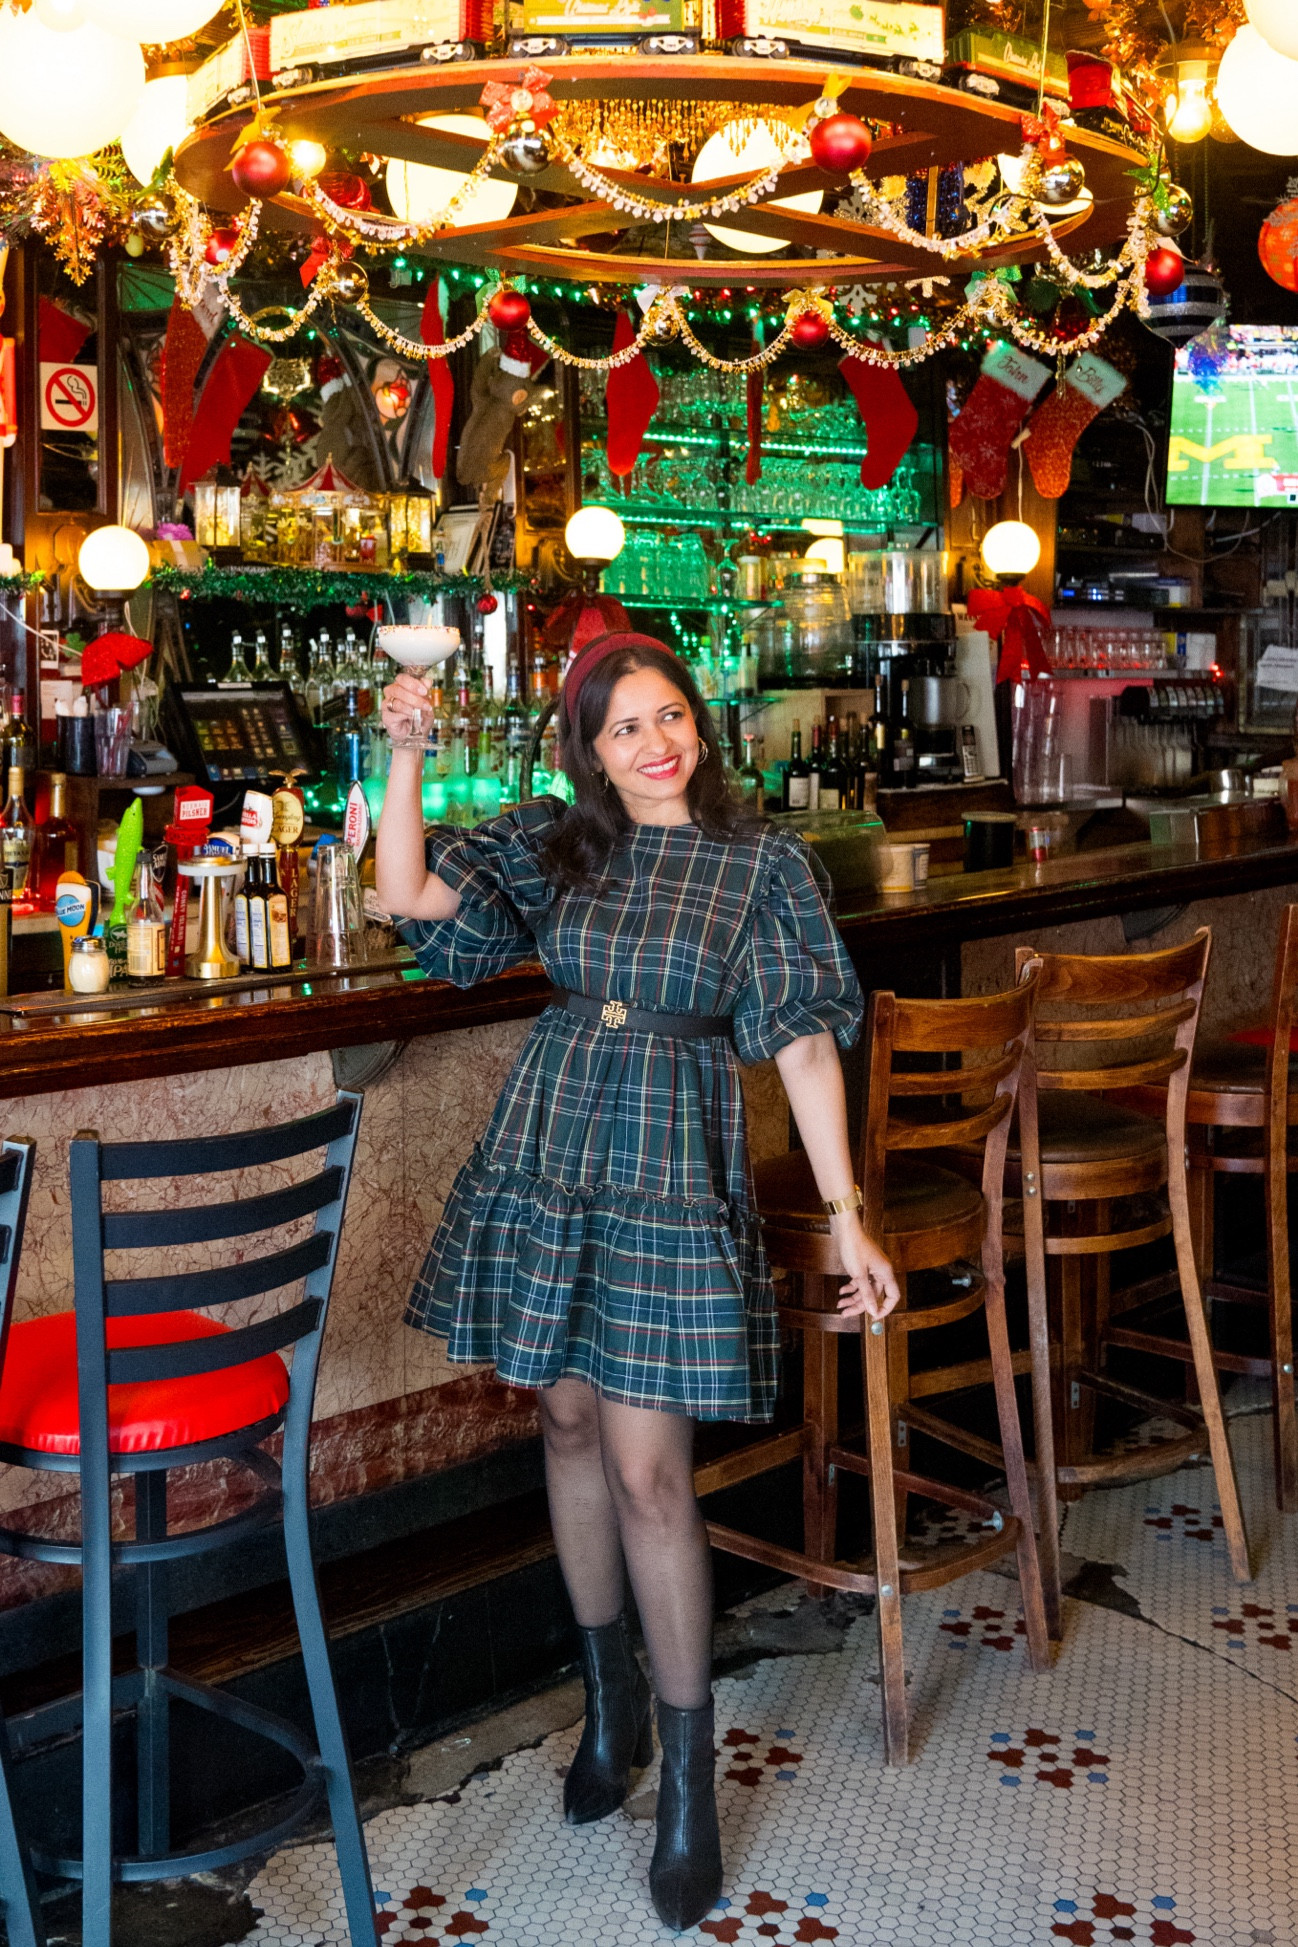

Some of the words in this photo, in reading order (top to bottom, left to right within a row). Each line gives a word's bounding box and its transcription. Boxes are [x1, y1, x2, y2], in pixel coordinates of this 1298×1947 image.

[1168, 434, 1272, 471] M
[182, 807, 208, 818] PILSNER
[274, 825, 299, 834] LAGER
[346, 801, 358, 845] PERONI
[203, 844, 230, 857] SAMUEL
[290, 868, 298, 917] LAGER
[67, 904, 85, 913] MOON
[109, 964, 128, 978] IPA
